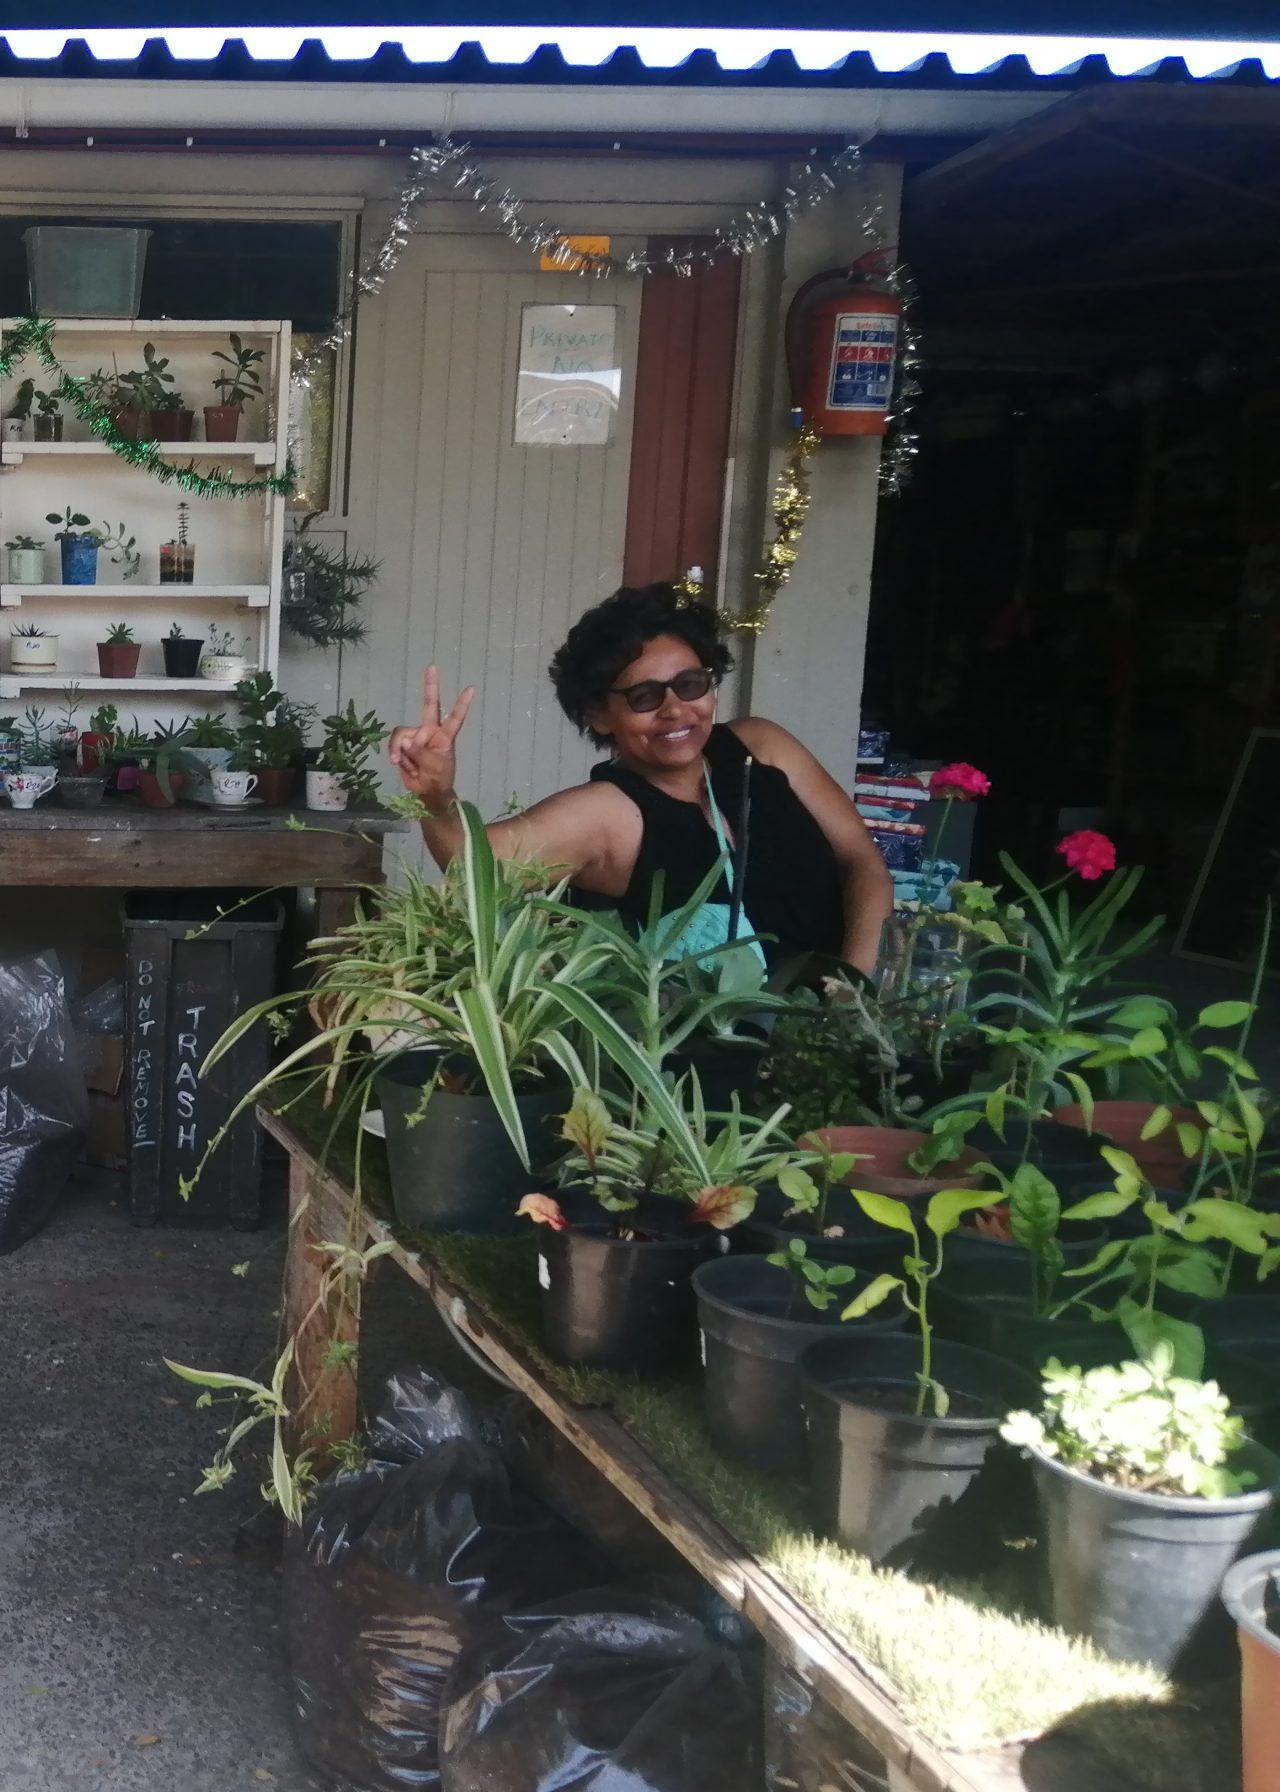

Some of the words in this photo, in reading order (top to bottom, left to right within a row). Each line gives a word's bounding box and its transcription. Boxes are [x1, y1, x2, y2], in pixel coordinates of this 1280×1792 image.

[551, 356, 595, 374] NO
[139, 960, 153, 986] DO
[138, 994, 155, 1036] NOT
[133, 1049, 151, 1138] REMOVE
[175, 1006, 206, 1151] TRASH
